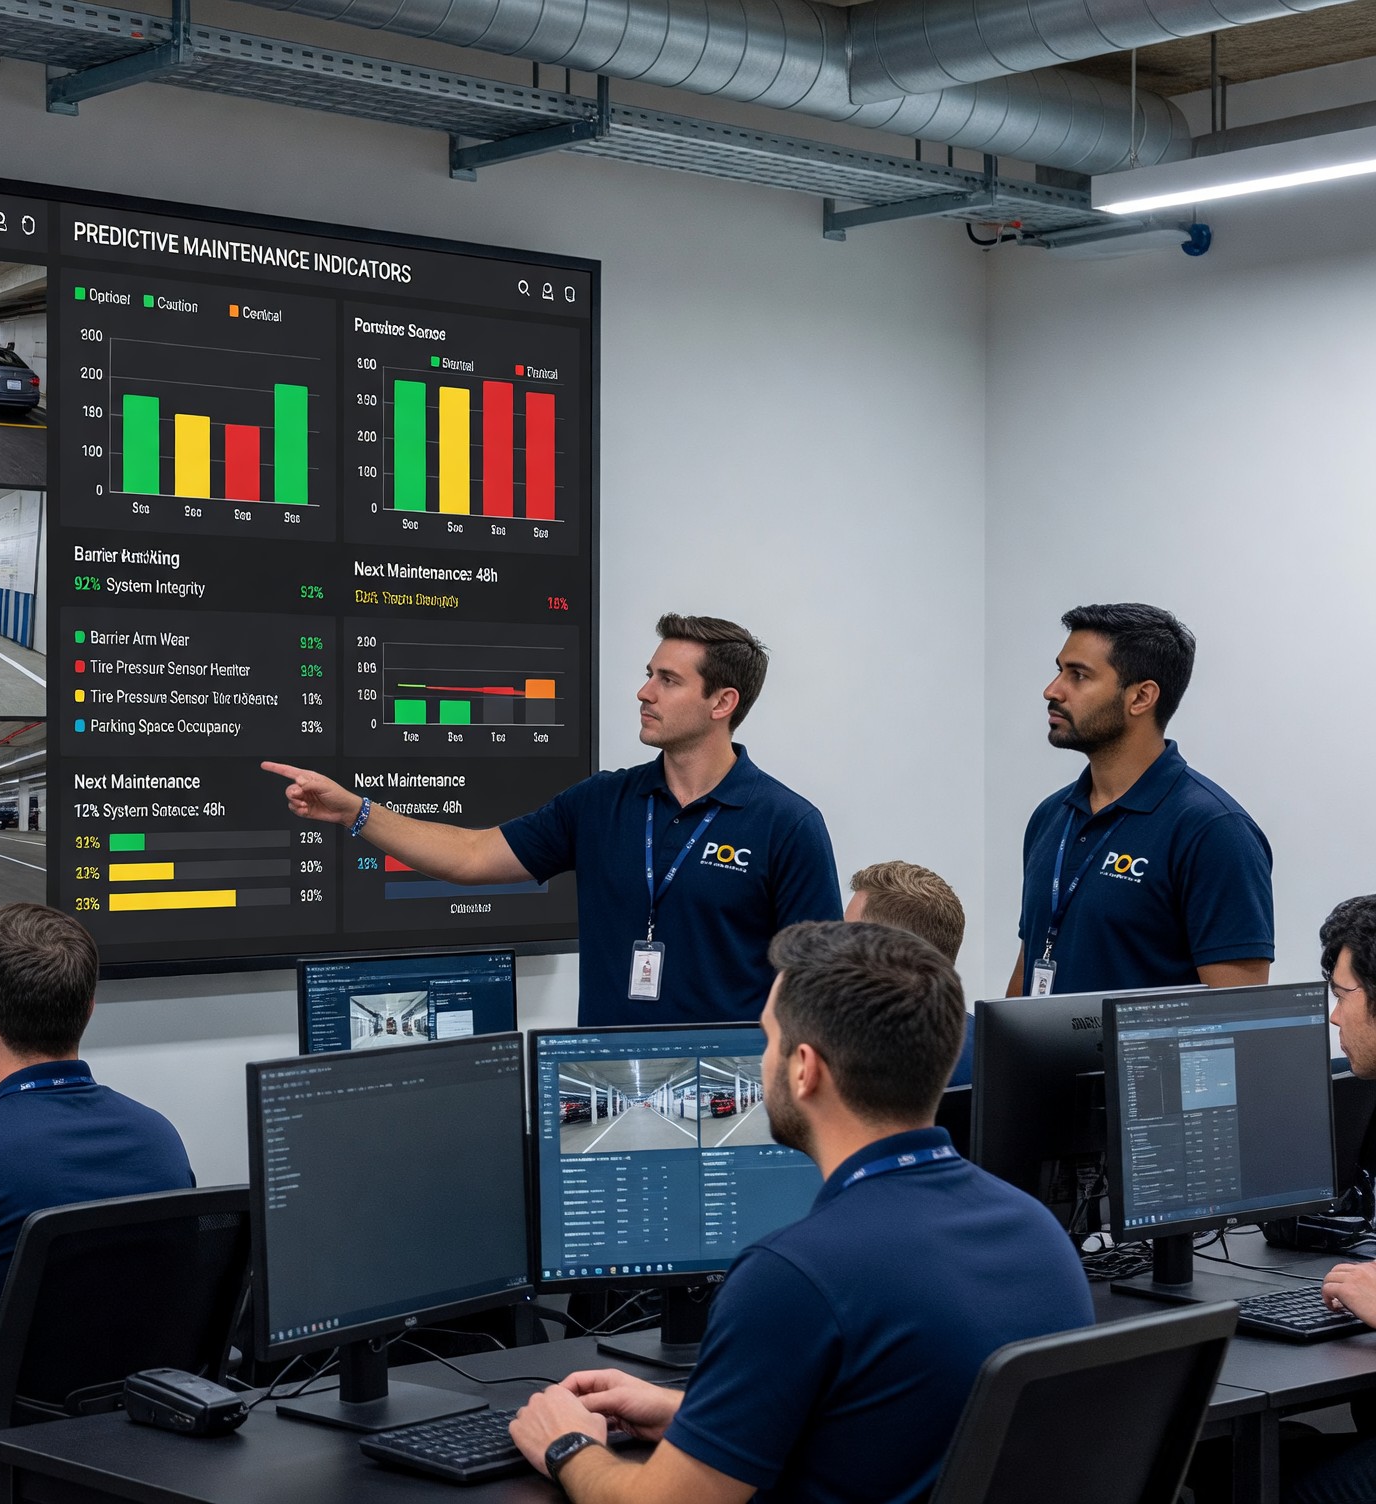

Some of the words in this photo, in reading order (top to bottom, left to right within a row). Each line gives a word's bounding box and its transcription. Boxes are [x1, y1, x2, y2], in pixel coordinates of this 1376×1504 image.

[75, 222, 179, 253] PREDICTIVE
[184, 236, 309, 269] MAINTENANCE
[315, 253, 411, 283] INDICATORS
[81, 367, 102, 380] 200
[97, 485, 102, 495] 0
[372, 503, 377, 513] 0
[75, 546, 118, 562] Barrier
[355, 561, 384, 576] Next
[476, 568, 497, 582] 48h
[75, 576, 100, 590] 92%
[107, 578, 151, 594] System
[157, 580, 205, 598] Integrity
[91, 631, 129, 644] Barrier
[133, 632, 156, 645] Arm
[160, 633, 189, 646] Wear
[90, 660, 113, 673] Tire
[168, 661, 208, 675] Sensor
[91, 690, 113, 702] Tire
[170, 691, 209, 704] Sensor
[91, 719, 135, 735] Parking
[139, 719, 174, 735] Space
[178, 720, 240, 736] Occupancy
[371, 719, 376, 729] 0
[75, 774, 106, 789] Next
[112, 774, 200, 789] Maintenance
[355, 773, 383, 787] Next
[388, 773, 465, 787] Maintenance
[74, 804, 99, 817] 12%
[103, 803, 148, 820] System
[203, 802, 225, 816] 48h
[443, 801, 462, 813] 48h
[701, 841, 752, 867] POC
[1101, 851, 1149, 877] POC
